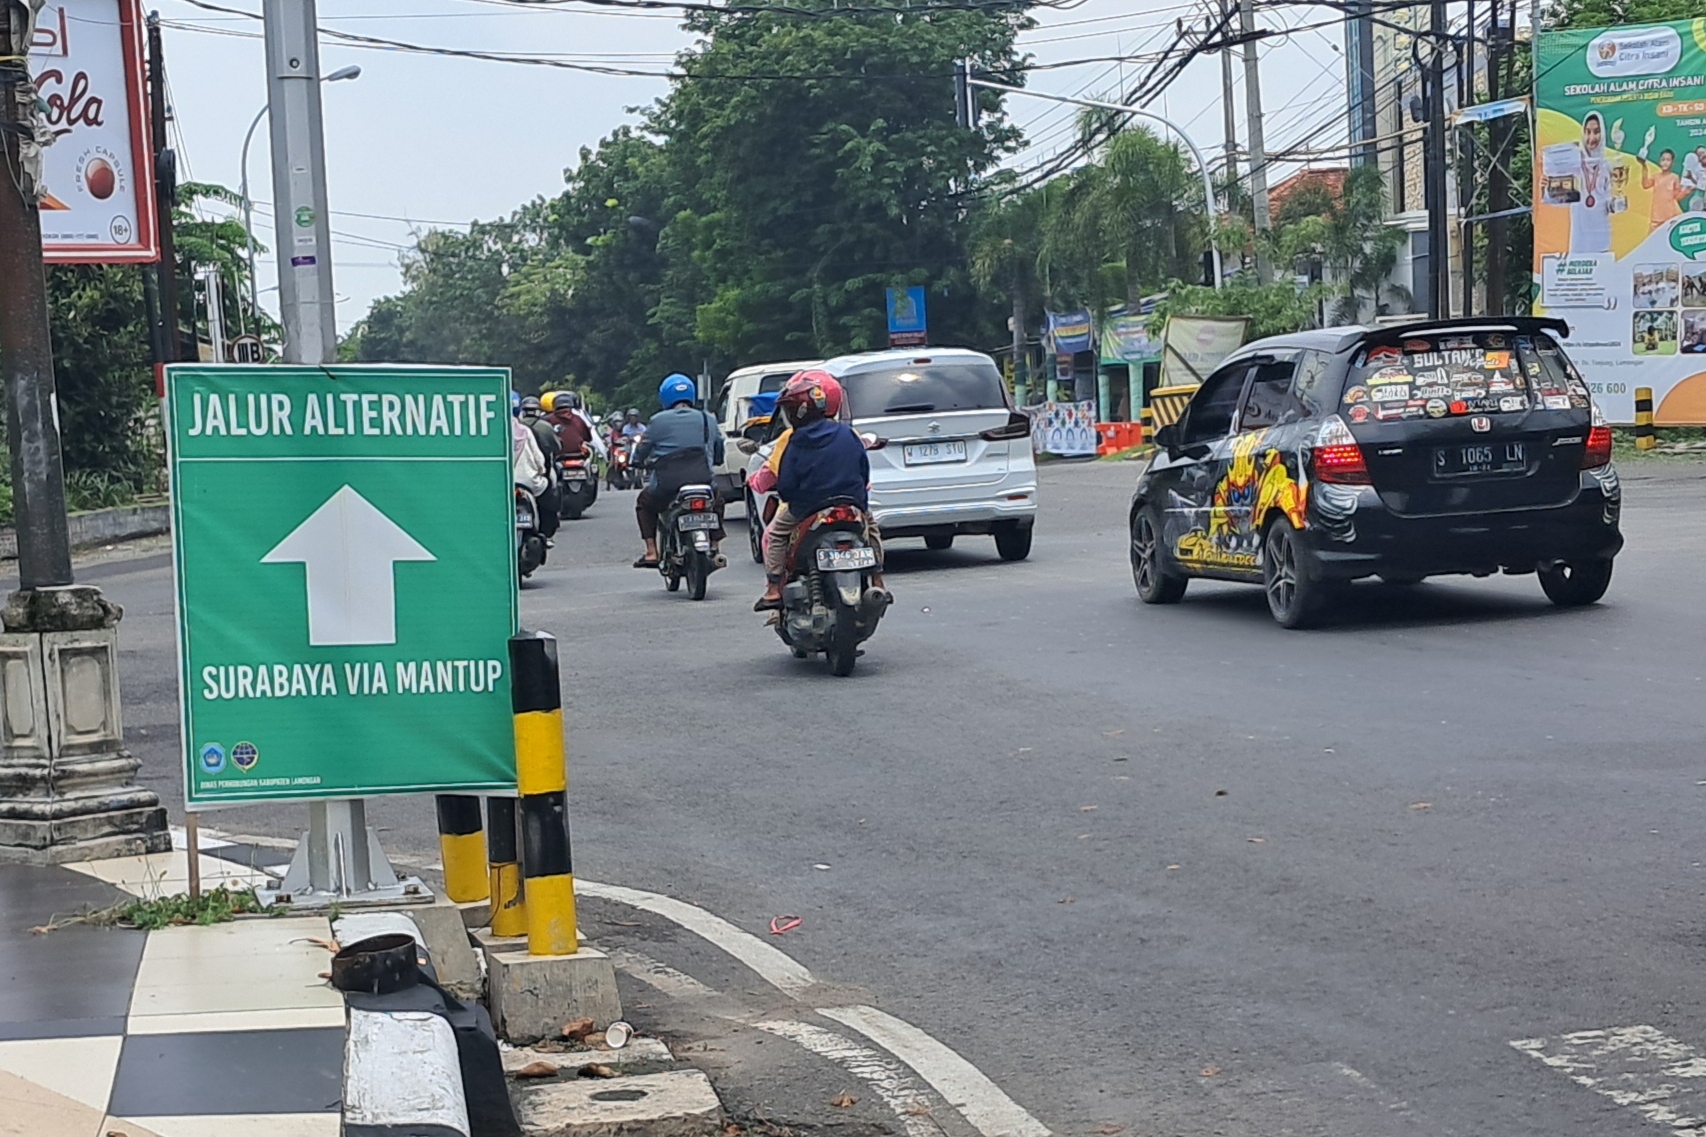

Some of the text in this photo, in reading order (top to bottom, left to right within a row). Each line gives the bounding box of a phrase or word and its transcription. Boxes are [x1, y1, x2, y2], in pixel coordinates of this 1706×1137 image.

[1619, 52, 1640, 61] Citra
[1564, 75, 1704, 96] SEKOLAH ALAM CITRA INSANI
[95, 146, 126, 192] CAPSULE
[113, 224, 129, 236] 18+
[1568, 259, 1598, 267] MERDEKA
[1606, 383, 1627, 394] 600
[188, 392, 497, 437] JALUR ALTERNATIF
[1437, 443, 1523, 466] S 1065 LN
[201, 659, 502, 700] SURABAYA VIA MANTUP
[200, 780, 217, 789] DINAS
[291, 776, 321, 785] LAMONGAN
